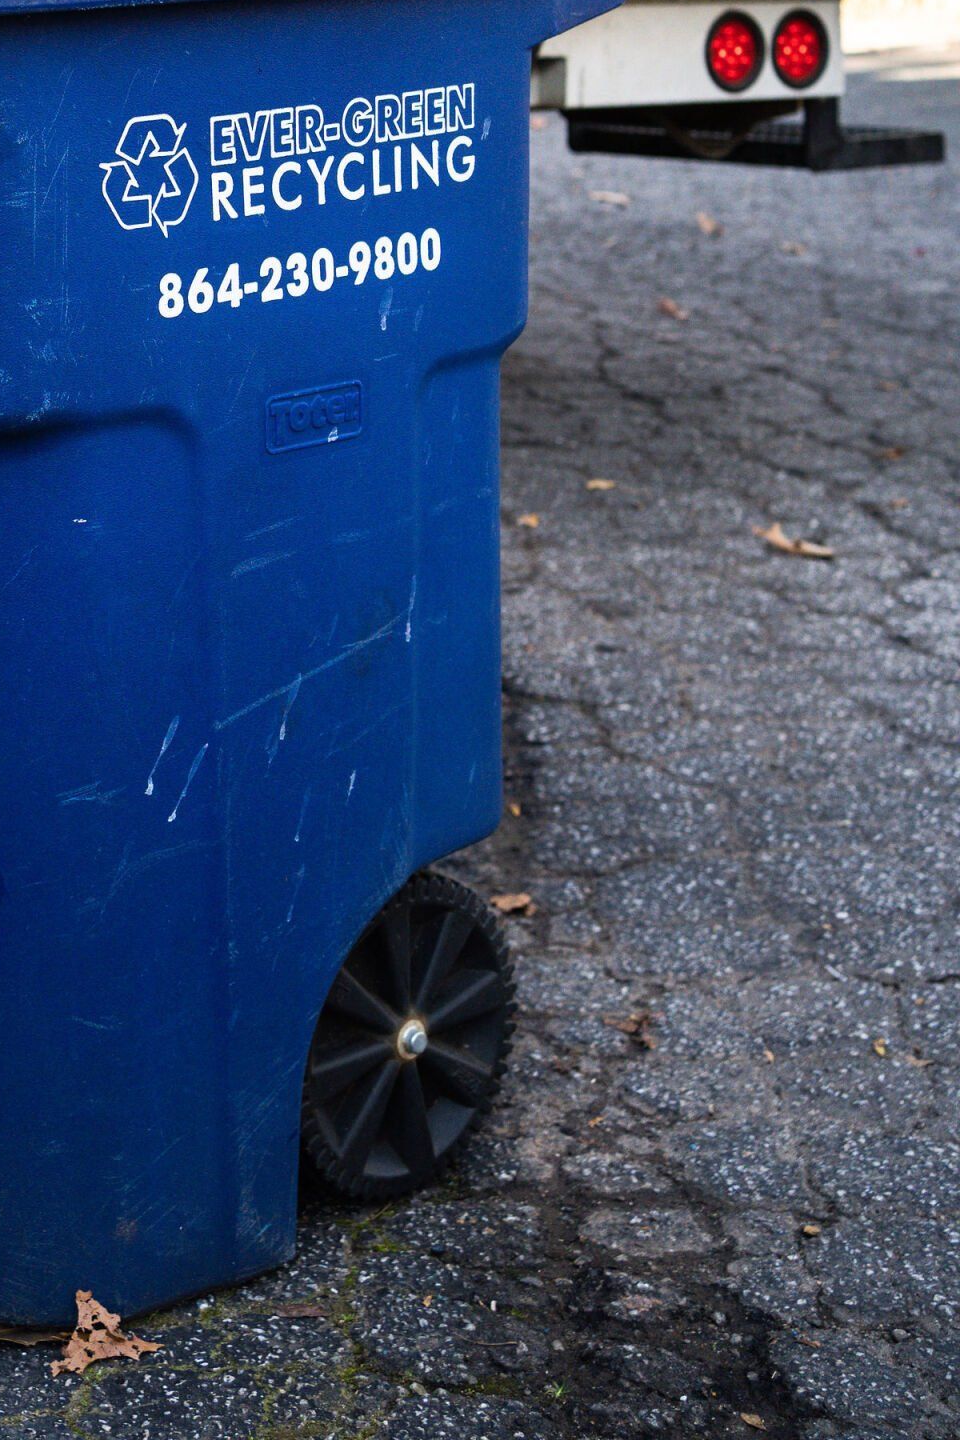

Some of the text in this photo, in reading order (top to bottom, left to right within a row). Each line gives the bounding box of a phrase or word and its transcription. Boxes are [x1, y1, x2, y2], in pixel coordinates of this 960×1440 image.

[210, 83, 476, 166] EVER-GREEN
[211, 136, 477, 221] RECYCLING
[158, 227, 442, 319] 864-230-9800
